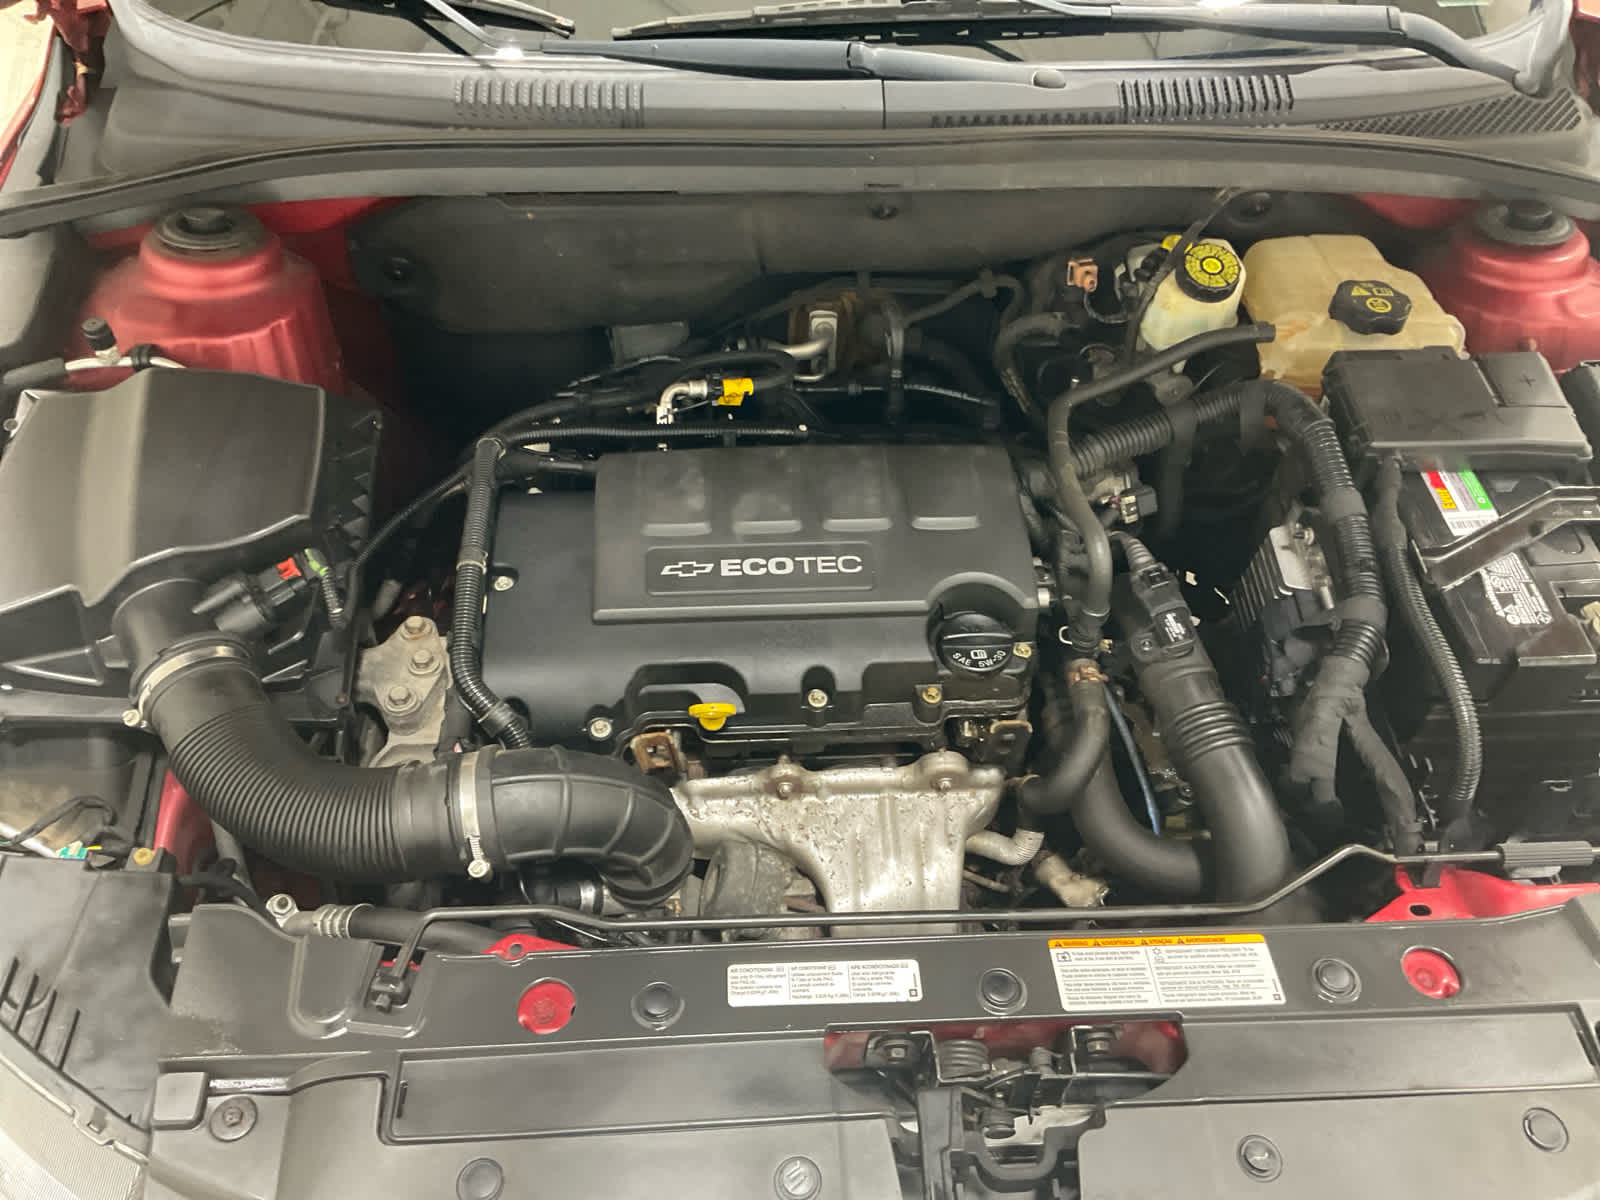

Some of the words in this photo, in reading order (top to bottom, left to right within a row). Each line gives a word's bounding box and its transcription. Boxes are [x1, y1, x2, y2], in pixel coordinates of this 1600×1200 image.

[720, 555, 863, 577] ECOTEC
[952, 652, 972, 666] SAE
[977, 650, 1007, 668] 5W-30
